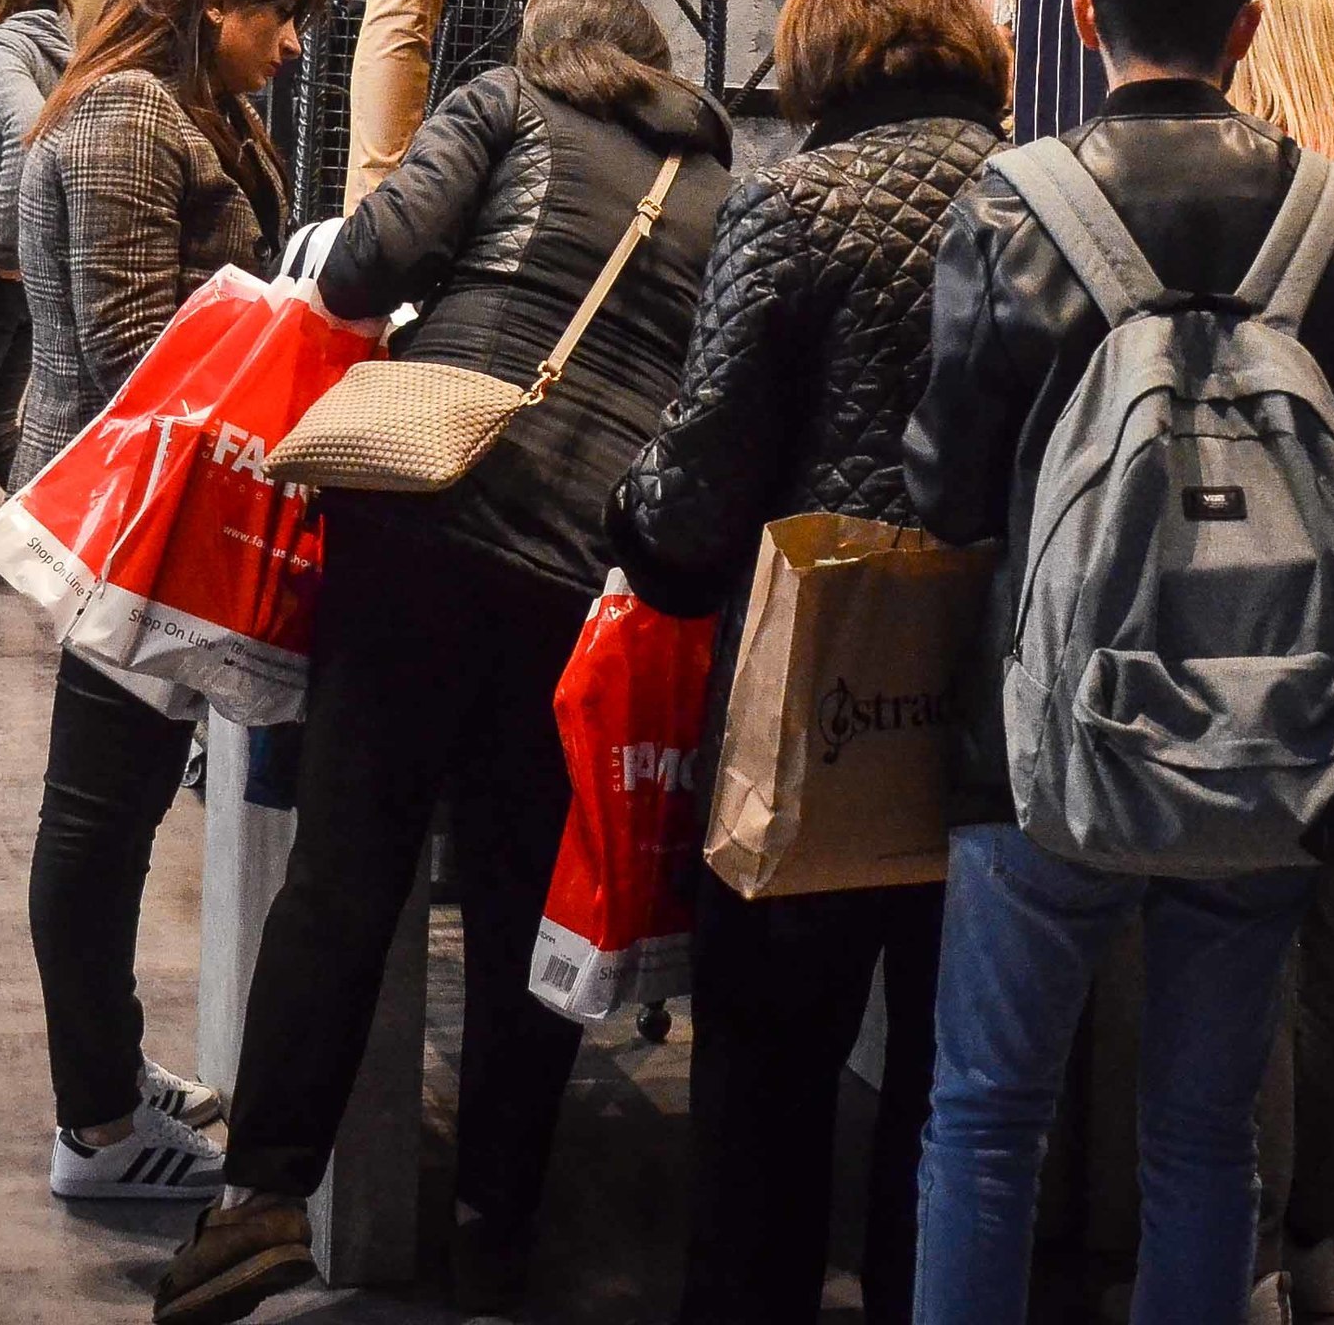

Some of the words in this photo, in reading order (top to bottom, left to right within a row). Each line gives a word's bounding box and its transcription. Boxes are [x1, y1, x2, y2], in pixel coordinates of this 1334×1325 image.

[26, 537, 54, 565] Shop
[65, 572, 85, 598] Line
[128, 609, 161, 632] Shop
[164, 622, 185, 641] On
[188, 631, 217, 652] Line
